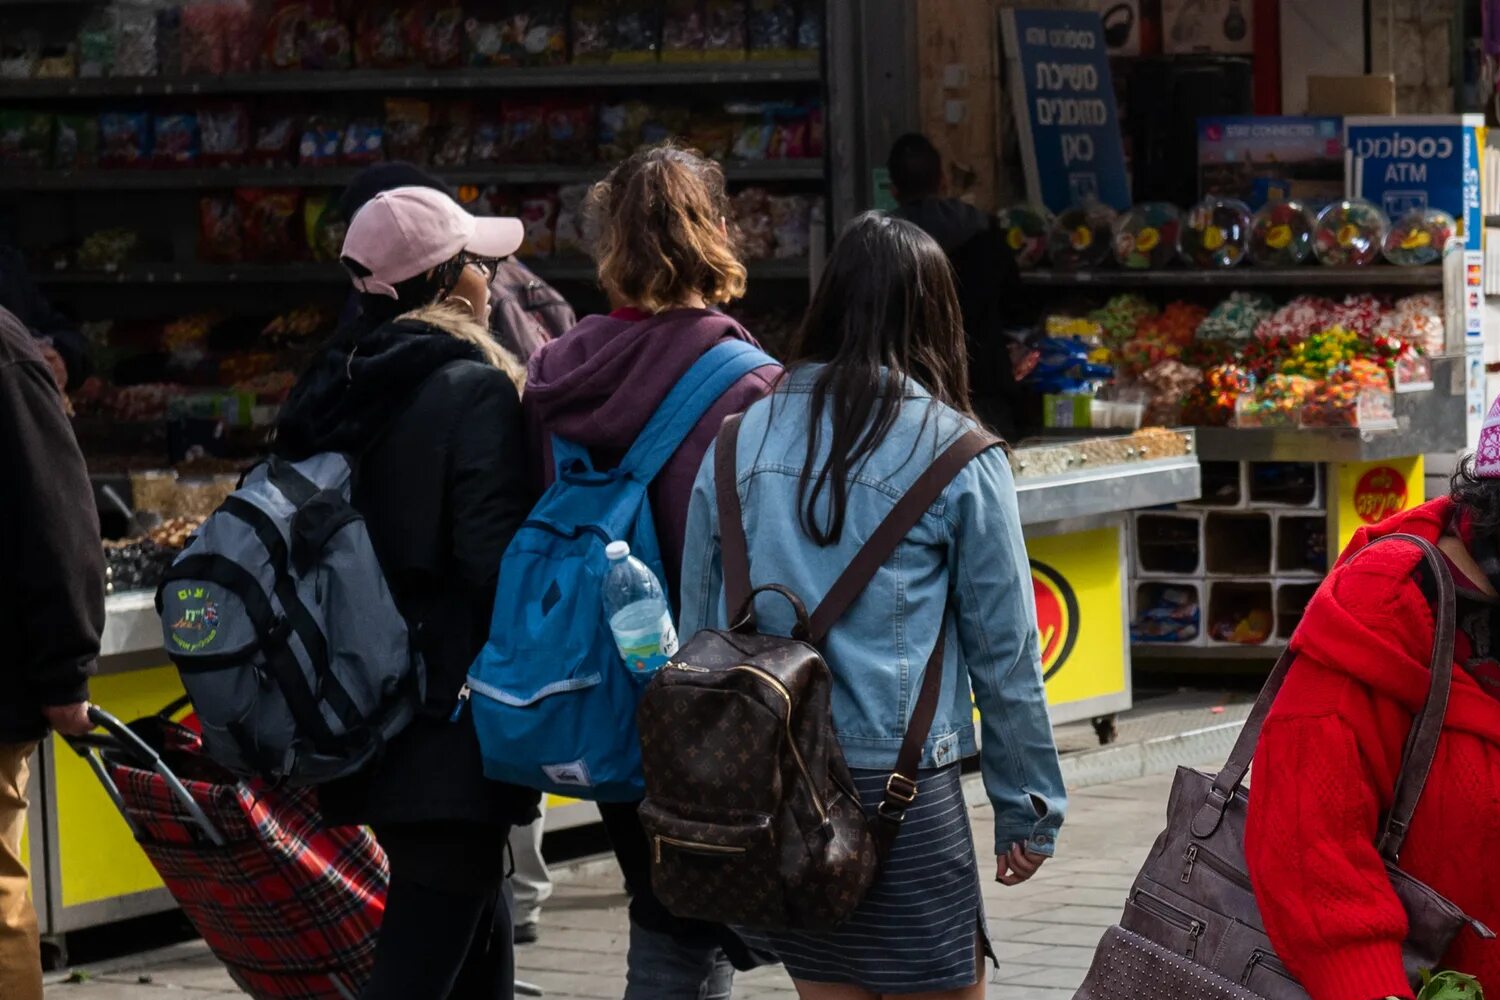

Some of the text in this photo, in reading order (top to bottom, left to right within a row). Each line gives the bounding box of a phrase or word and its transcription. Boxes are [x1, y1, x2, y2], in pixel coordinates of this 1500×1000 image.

[1036, 62, 1098, 91] משיכת
[1036, 98, 1107, 126] מזומנים
[1061, 133, 1095, 167] כאן
[1385, 163, 1427, 182] ATM
